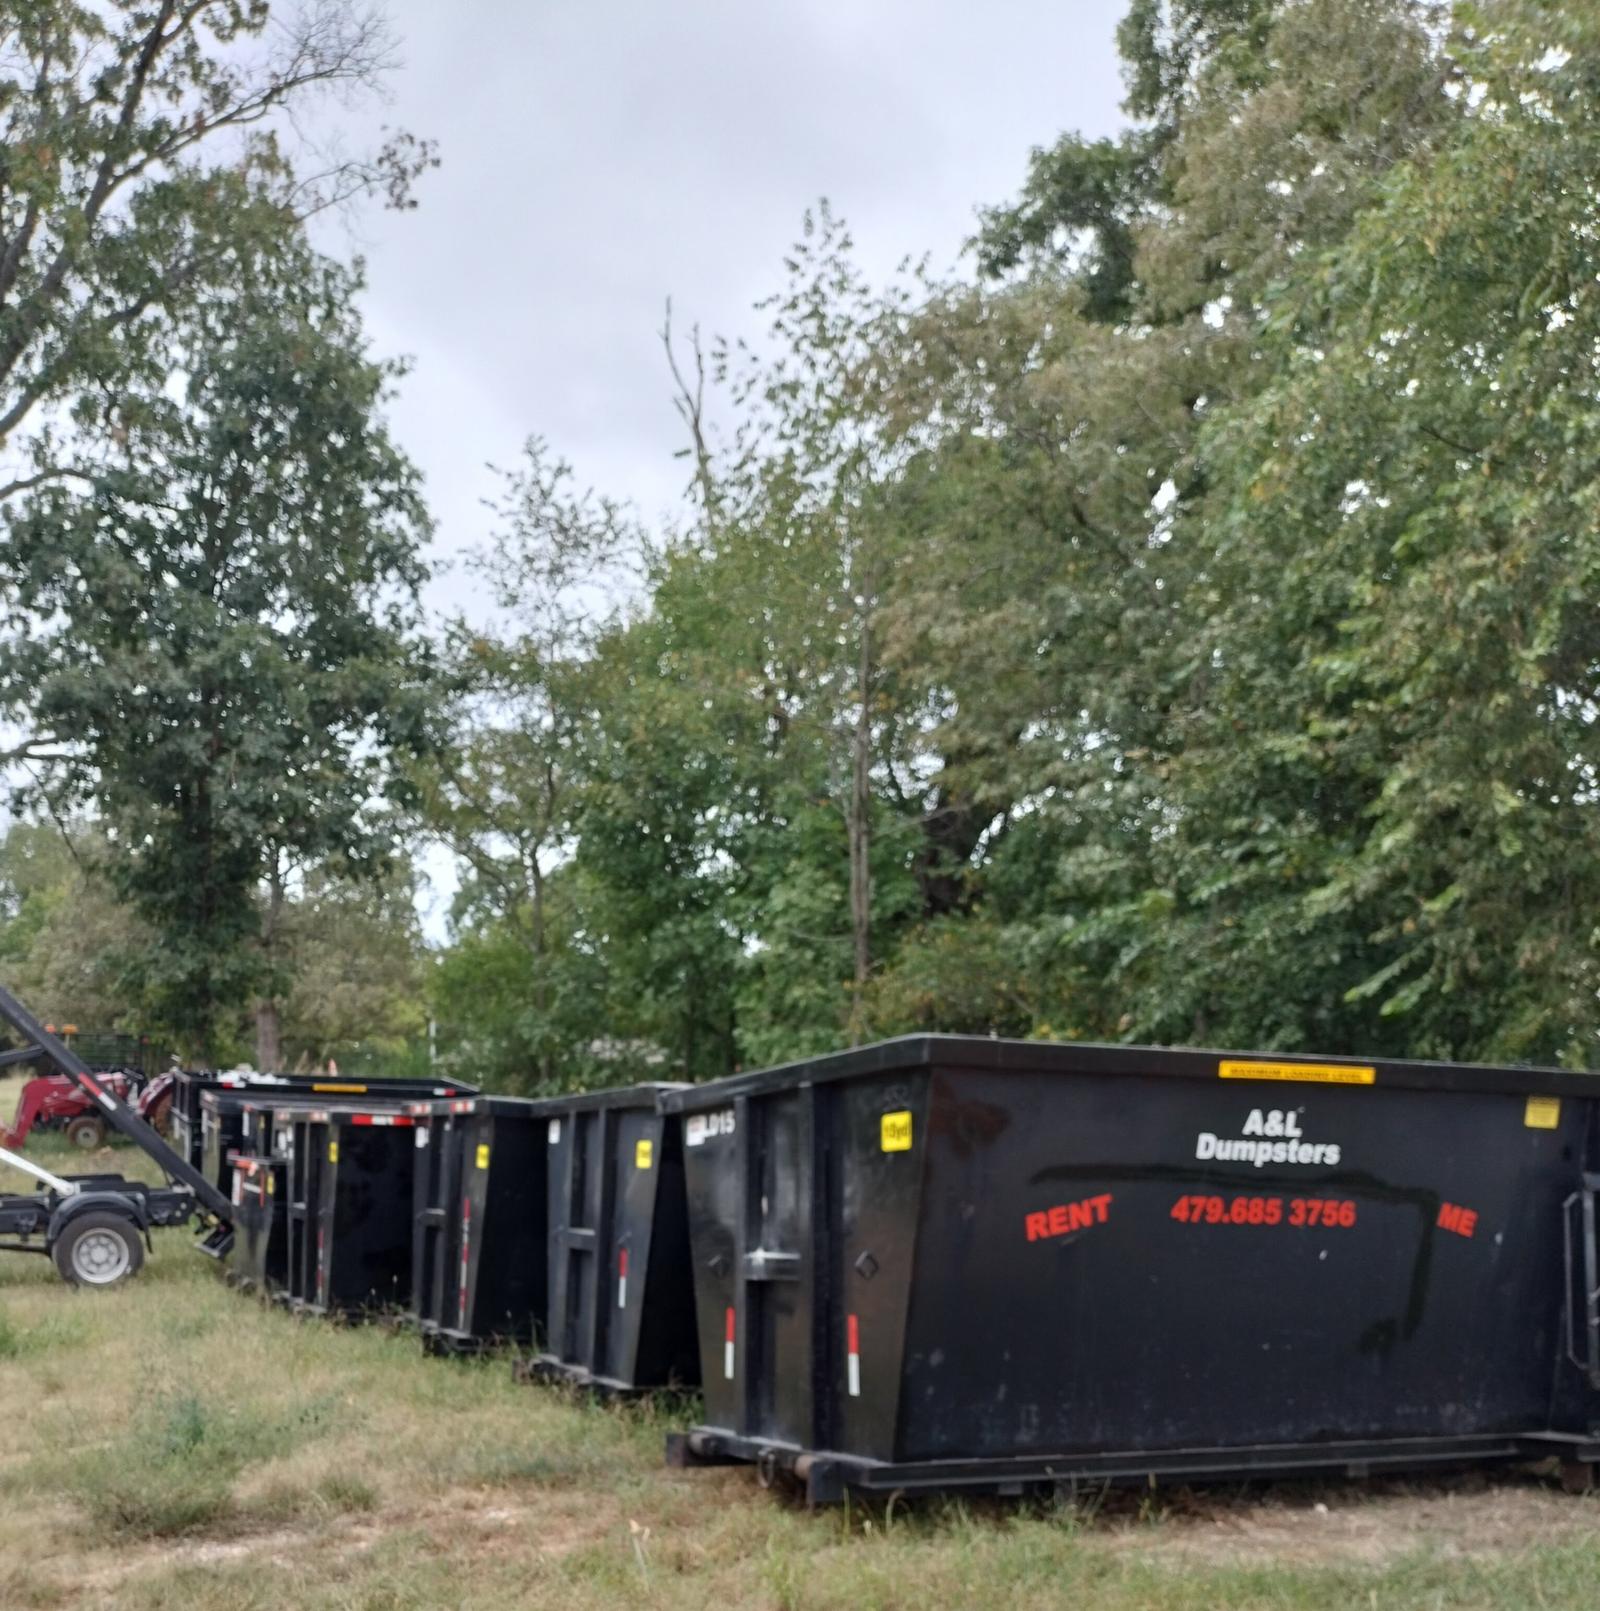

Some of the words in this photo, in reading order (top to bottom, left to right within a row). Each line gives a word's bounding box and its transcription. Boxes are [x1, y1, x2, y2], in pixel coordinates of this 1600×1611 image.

[1242, 1109, 1303, 1137] A&L
[1196, 1132, 1341, 1168] Dumpsters
[1025, 1193, 1112, 1242] RENT
[1170, 1195, 1283, 1225] 479.685
[1288, 1199, 1357, 1227] 3756
[1436, 1202, 1479, 1238] ME
